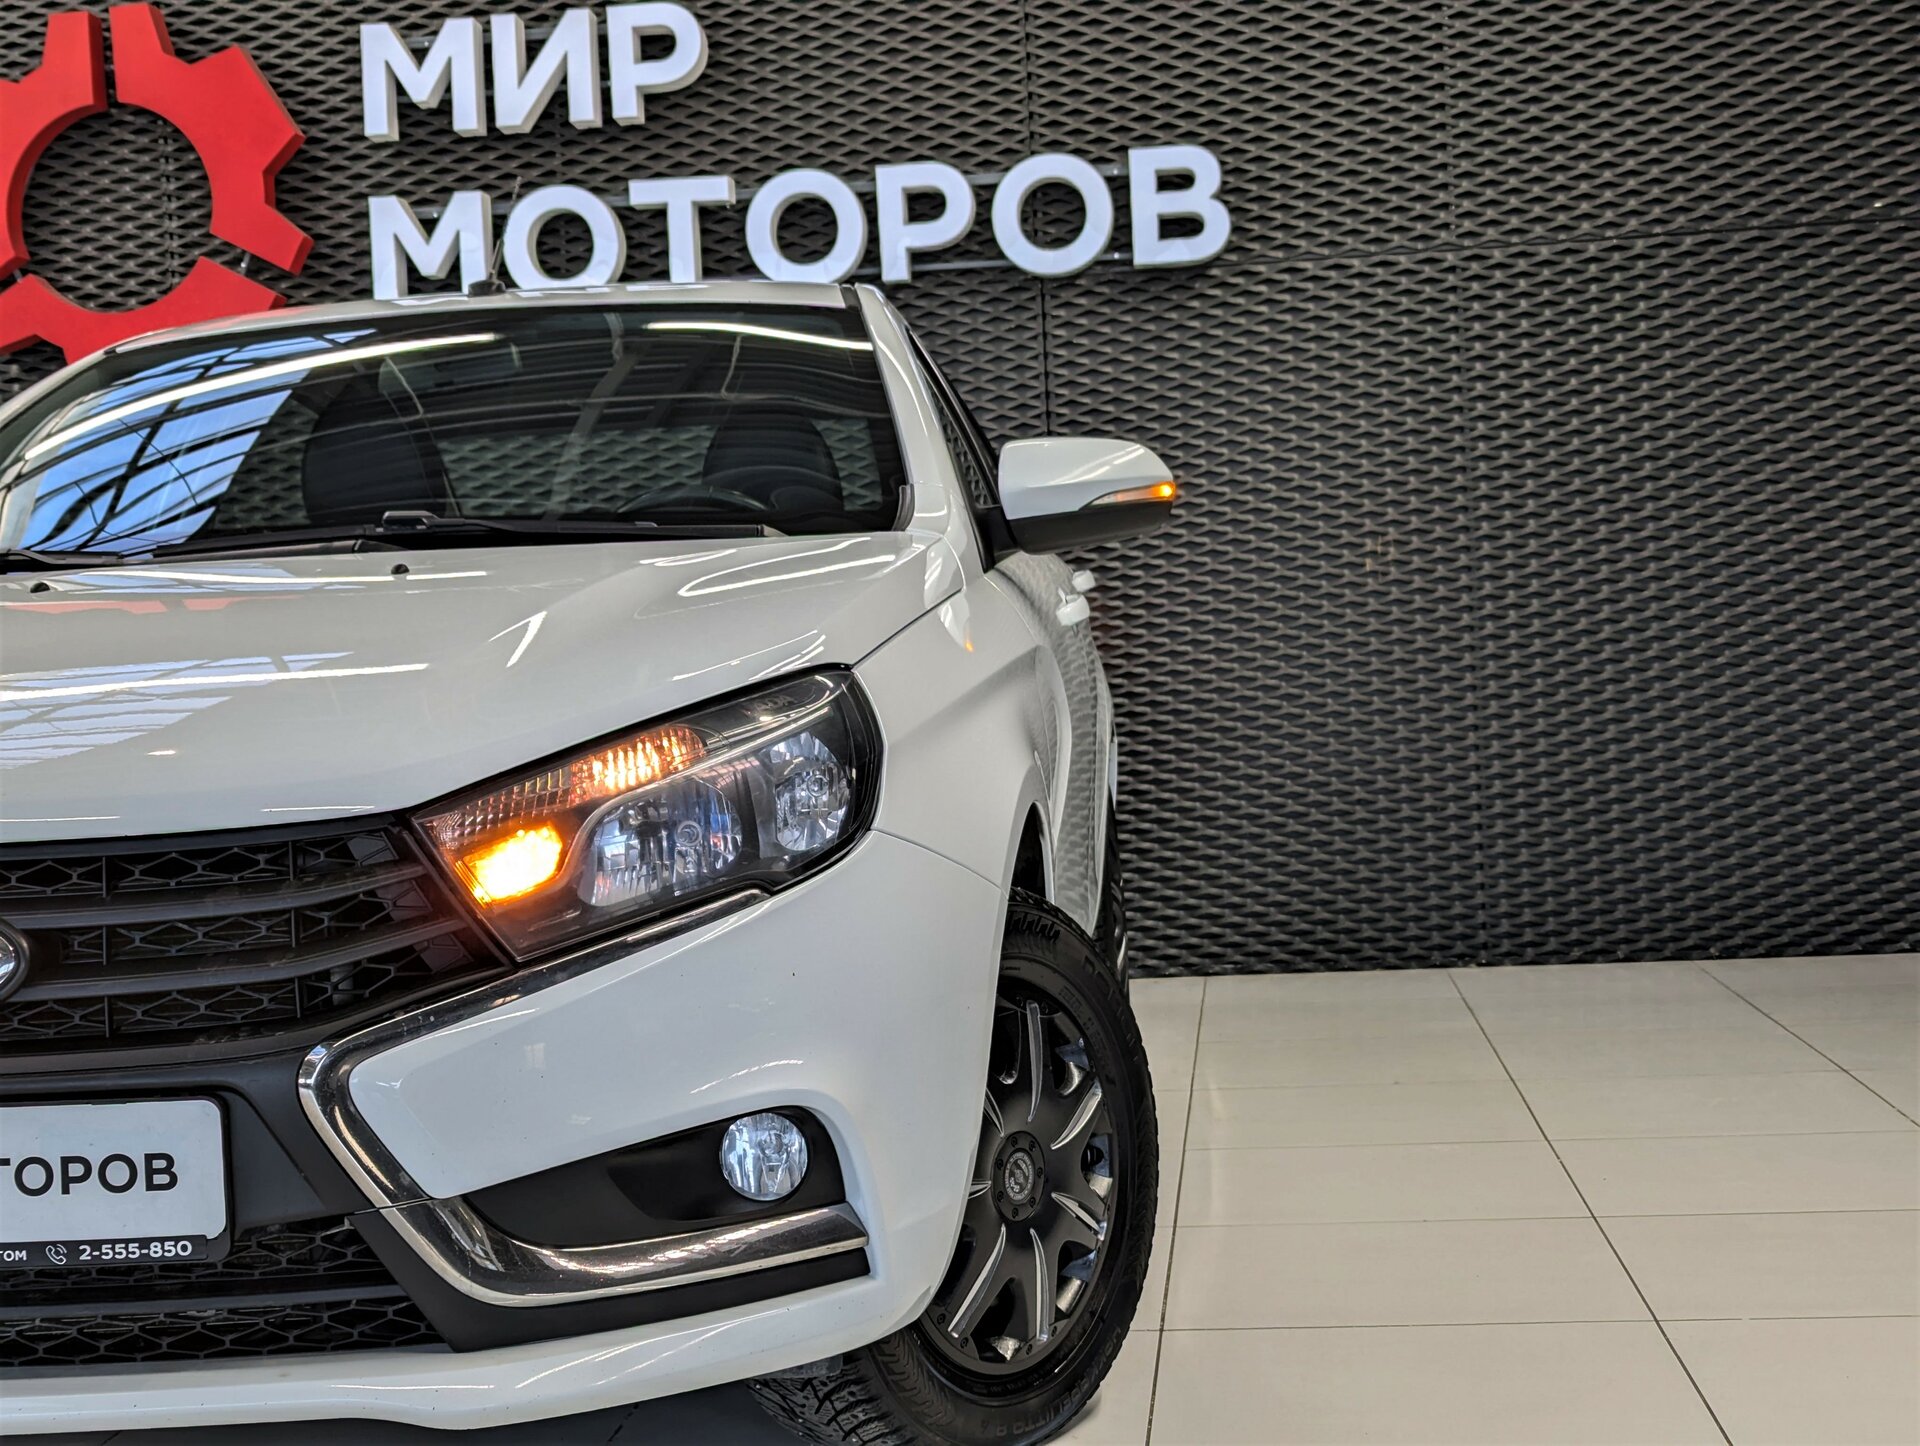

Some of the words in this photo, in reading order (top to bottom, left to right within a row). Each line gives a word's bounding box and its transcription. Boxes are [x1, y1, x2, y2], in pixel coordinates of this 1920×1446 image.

[359, 2, 709, 141] МИР
[367, 144, 1232, 299] МОТОРОВ
[79, 1240, 193, 1261] 2-555-850
